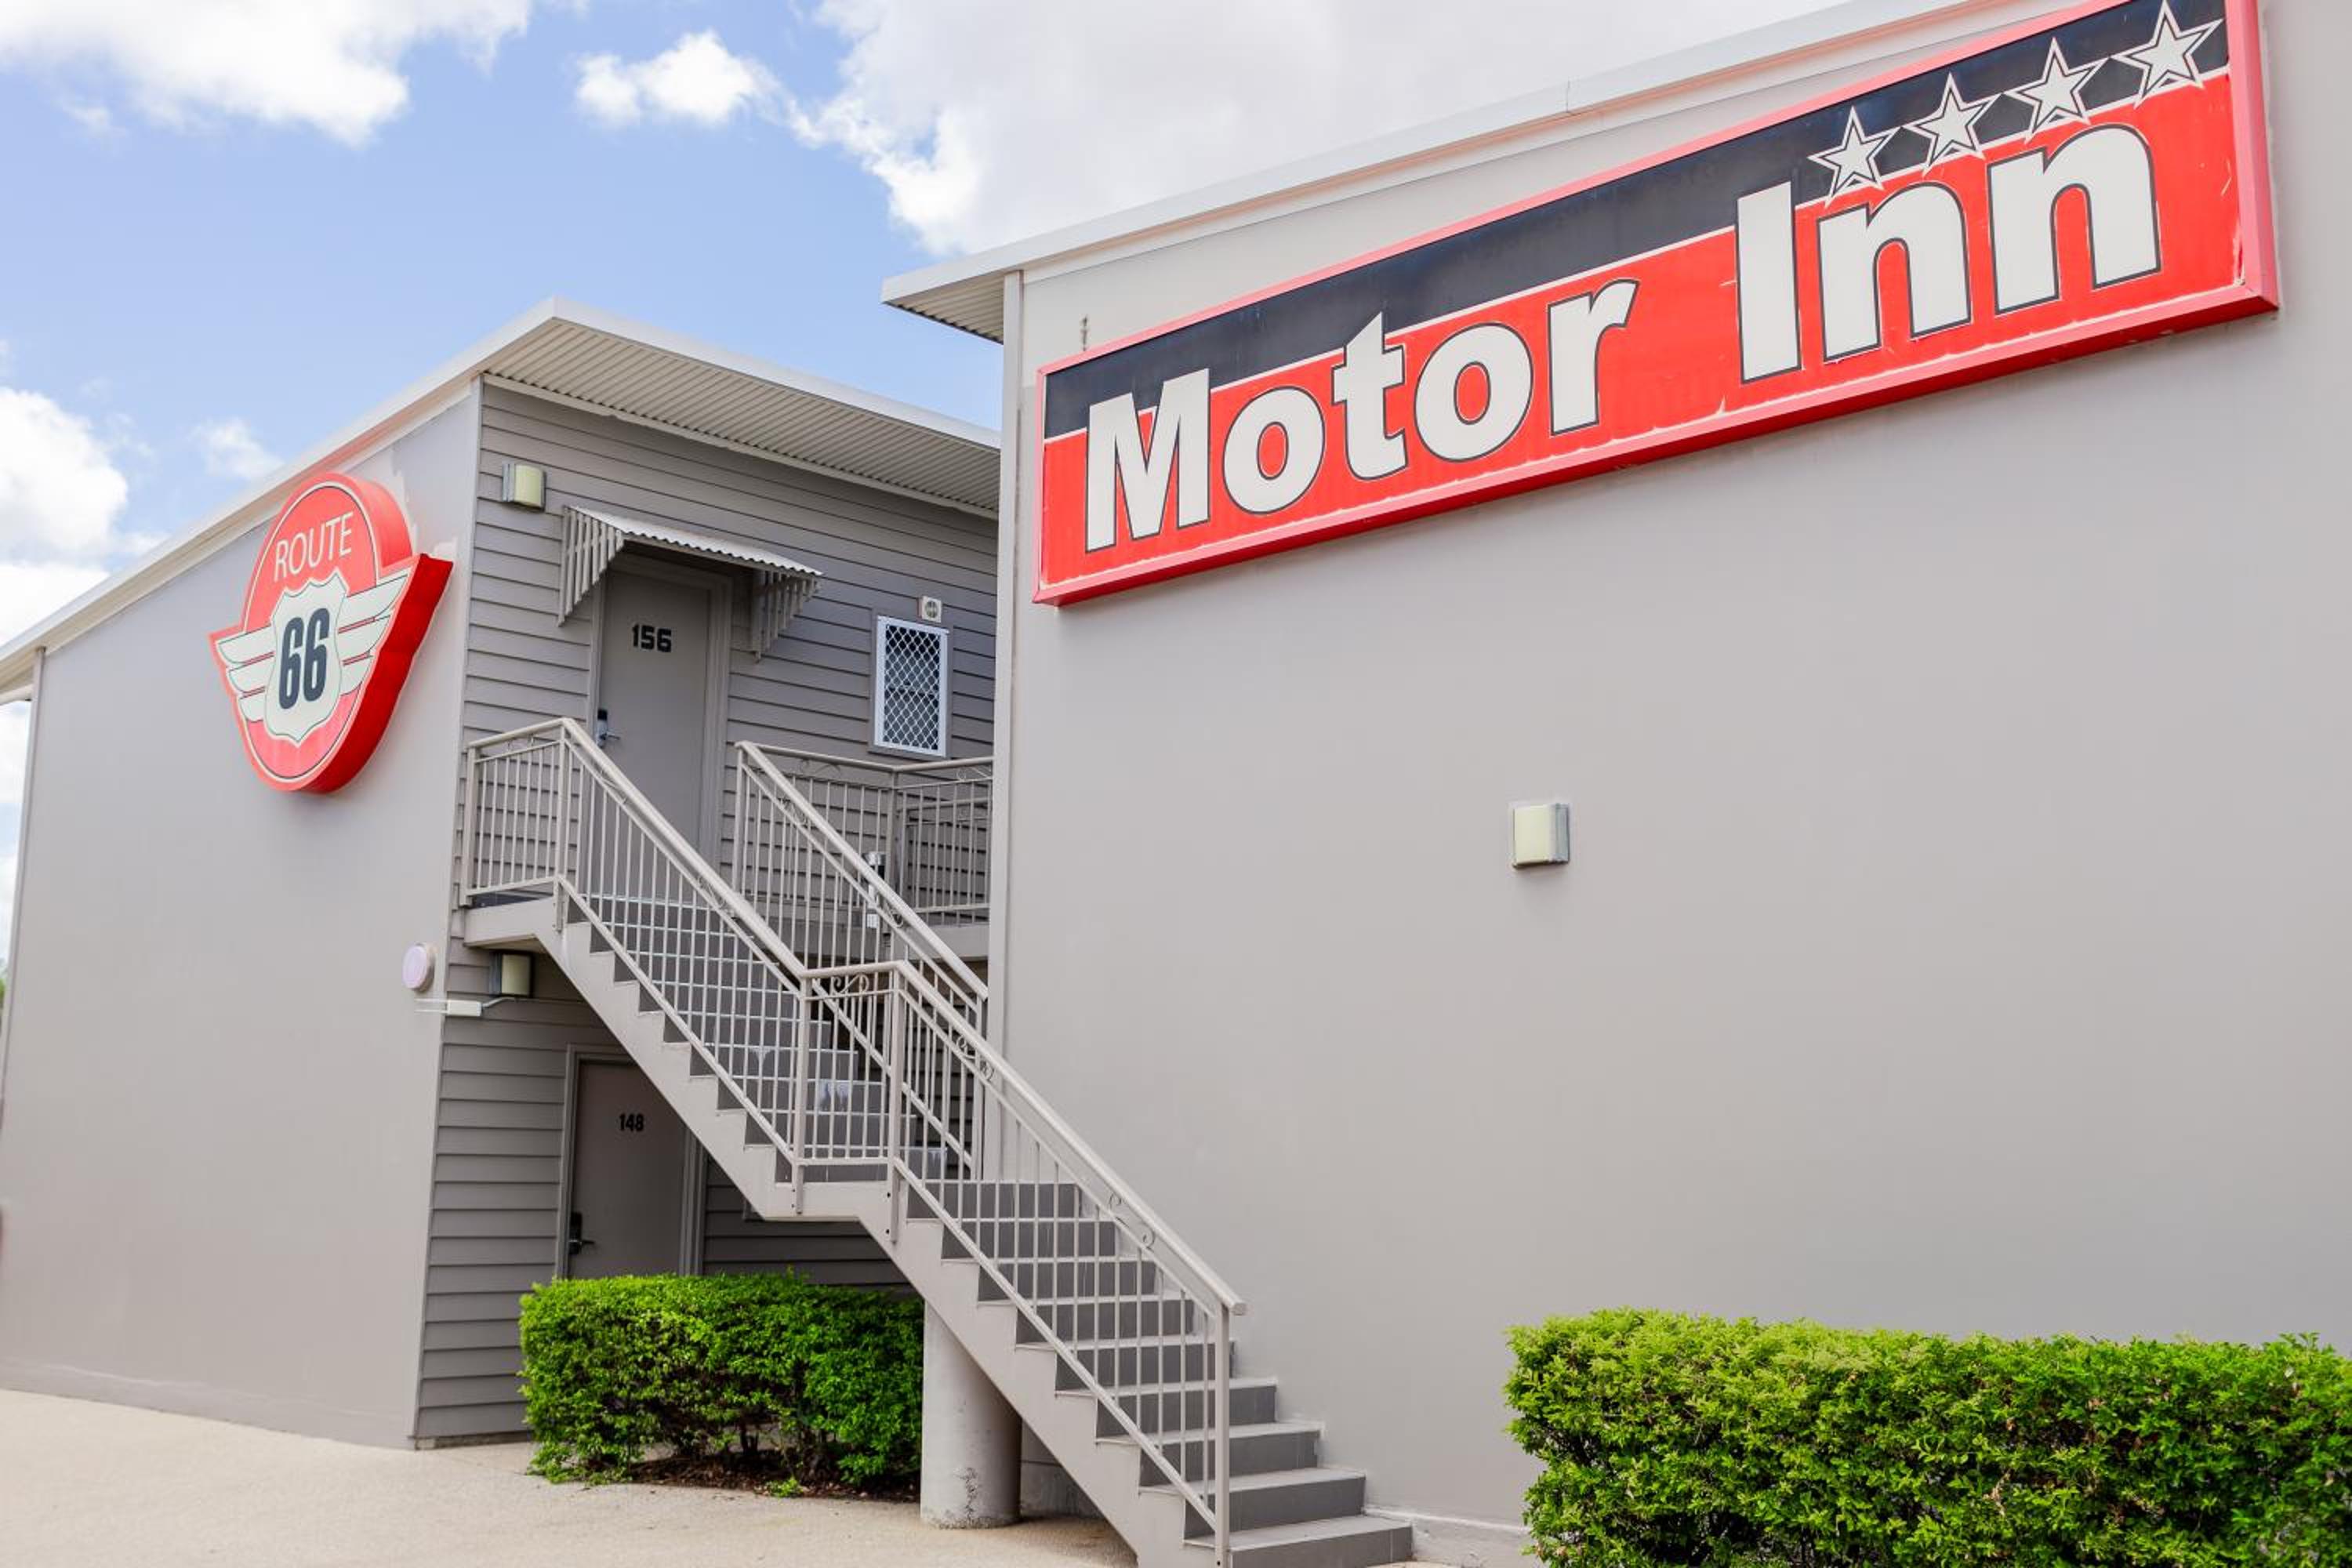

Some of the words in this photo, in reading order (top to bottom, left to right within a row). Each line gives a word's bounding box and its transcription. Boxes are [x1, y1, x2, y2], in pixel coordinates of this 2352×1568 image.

[1085, 279, 1638, 553] Motor
[1736, 122, 2161, 382] Inn
[274, 512, 353, 581] ROUTE
[278, 608, 330, 710] 66
[632, 624, 672, 653] 156
[619, 1113, 644, 1131] 148
